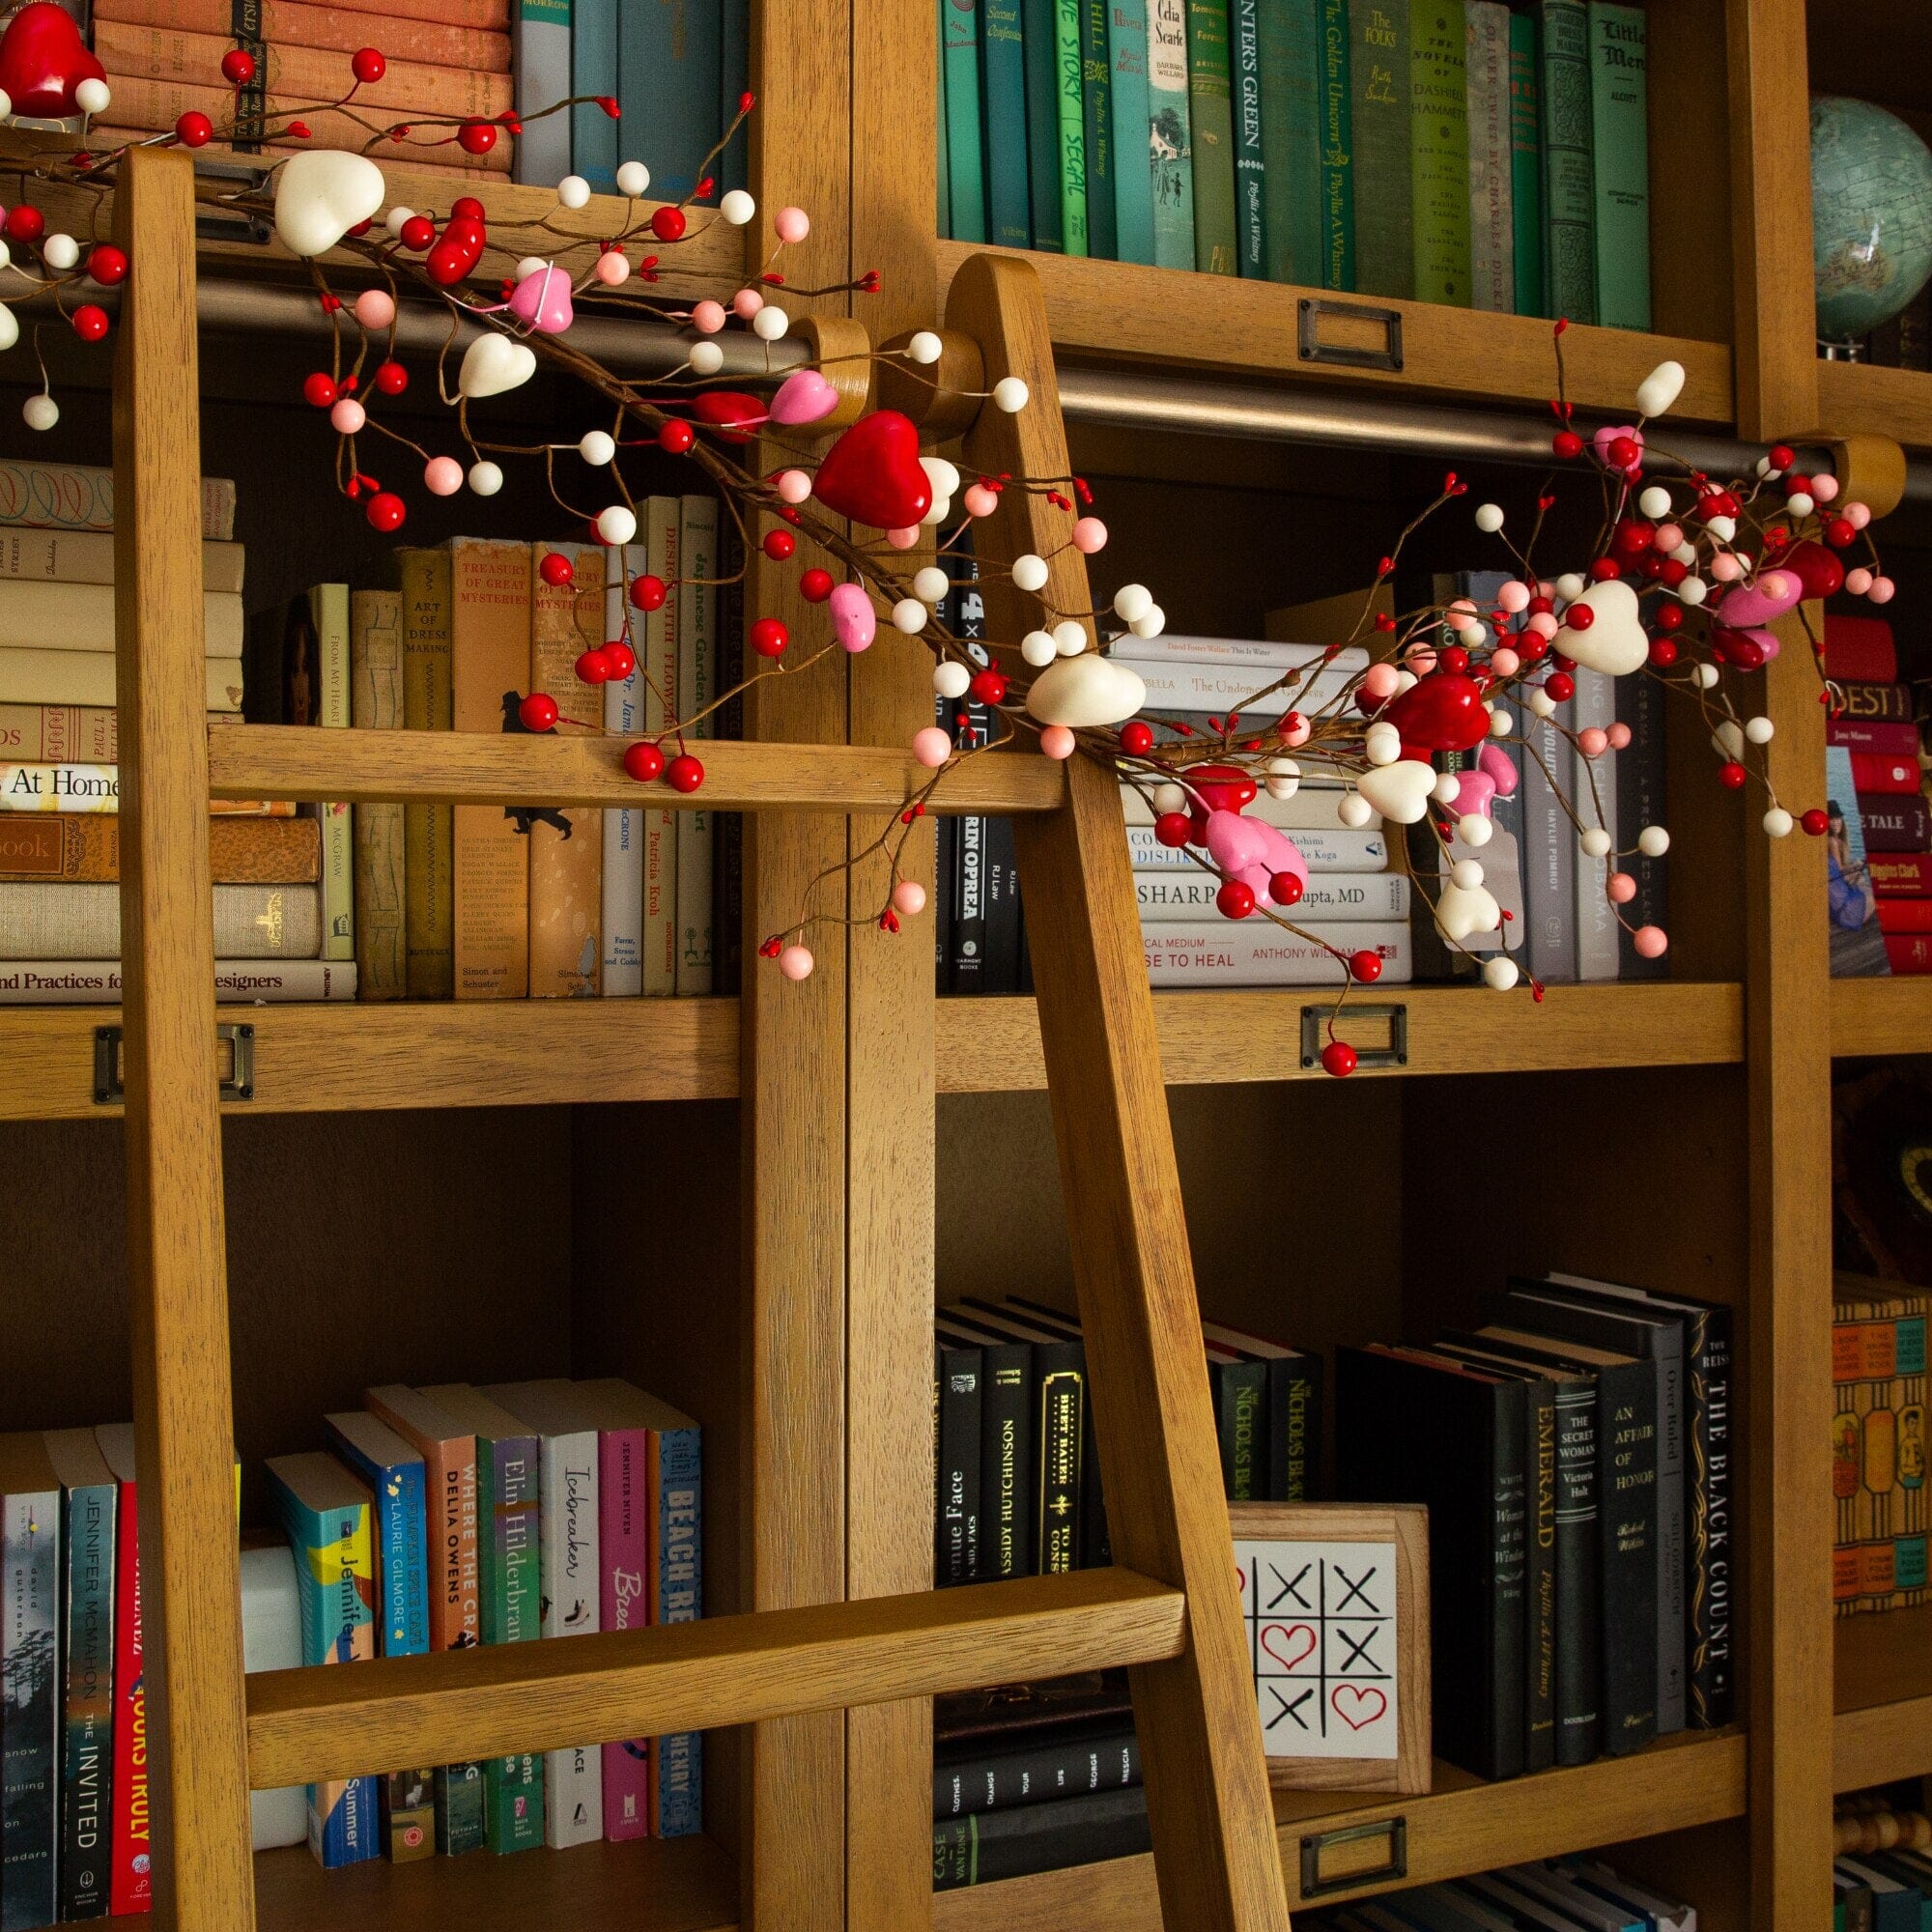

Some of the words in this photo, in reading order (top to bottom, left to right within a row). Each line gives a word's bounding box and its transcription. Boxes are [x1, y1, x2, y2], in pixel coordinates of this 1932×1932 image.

[1372, 11, 1390, 29] The
[1598, 19, 1646, 44] Little
[1063, 37, 1082, 104] STORY
[1324, 27, 1343, 80] Golden
[1486, 25, 1497, 85] OLIVER
[1598, 45, 1646, 69] Men
[1242, 77, 1260, 150] GREEN
[1326, 83, 1344, 145] Unicorn
[1488, 97, 1498, 141] TWIST
[1065, 133, 1086, 197] SEGAL
[1489, 150, 1499, 167] BY
[1330, 173, 1344, 214] Phyllis
[1490, 177, 1502, 250] CHARLES
[1328, 230, 1344, 290] Whitney
[12, 537, 20, 574] STREET
[463, 562, 526, 576] TREASURY
[665, 526, 676, 580] DESIG
[460, 593, 529, 606] MYSTERIES
[465, 579, 483, 588] OF
[486, 578, 526, 591] GREAT
[696, 553, 708, 634] Japanese
[413, 602, 440, 612] ART
[419, 616, 437, 625] OF
[665, 598, 675, 644] WITH
[406, 643, 449, 654] MAKING
[409, 629, 447, 639] DRESS
[1167, 641, 1186, 651] David
[1187, 642, 1207, 652] Foster
[1208, 643, 1231, 654] Wallace
[1230, 645, 1244, 655] This
[1252, 647, 1271, 657] Water
[330, 636, 340, 667] FROM
[330, 669, 340, 687] MY
[695, 639, 707, 703] Garden
[1191, 677, 1213, 693] The
[330, 688, 341, 724] HEART
[11, 768, 43, 795] At
[51, 770, 118, 797] Home
[1547, 810, 1557, 844] HAYLIE
[1868, 815, 1905, 830] TALE
[0, 834, 51, 858] ook
[108, 830, 117, 867] BONANZA
[649, 831, 661, 880] Patricia
[1315, 850, 1338, 862] Koga
[962, 852, 980, 921] OPREA
[991, 865, 1001, 879] RJ
[1548, 848, 1559, 892] POMROY
[649, 886, 661, 917] Kroh
[991, 880, 1001, 901] Law
[1137, 885, 1216, 904] SHARP
[1338, 889, 1365, 903] MD
[1165, 938, 1206, 949] MEDIUM
[1168, 954, 1191, 968] TO
[1195, 953, 1235, 968] HEAL
[1251, 948, 1308, 960] ANTHONY
[23, 973, 103, 990] Practices
[323, 966, 332, 998] WHITNEY
[462, 967, 490, 976] Simon
[492, 967, 508, 976] and
[462, 980, 500, 989] Schuster
[1666, 1369, 1678, 1408] Over
[1059, 1393, 1069, 1432] BRET
[1570, 1416, 1589, 1428] THE
[1614, 1406, 1634, 1422] AN
[1708, 1379, 1728, 1442] THE
[1559, 1443, 1596, 1459] WOMAN
[1560, 1430, 1595, 1444] SECRET
[1614, 1424, 1656, 1446] AFFAIR
[1666, 1413, 1679, 1461] Ruled
[622, 1441, 631, 1502] JENNIFER
[1000, 1419, 1013, 1521] HUTCHINSON
[1058, 1437, 1068, 1485] BAIER
[1614, 1452, 1633, 1467] OF
[504, 1459, 526, 1507] Elin
[1538, 1406, 1554, 1548] EMERALD
[1562, 1471, 1595, 1484] Victoria
[1571, 1485, 1589, 1498] Holt
[1615, 1469, 1656, 1491] HONOR
[446, 1470, 459, 1528] DELIA
[462, 1463, 476, 1540] WHERE
[946, 1469, 963, 1520] Face
[1708, 1454, 1728, 1550] BLACK
[391, 1501, 404, 1554] LAURIE
[564, 1467, 590, 1579] Icebreaker
[622, 1504, 631, 1536] NIVEN
[668, 1490, 695, 1582] BEACH
[1061, 1524, 1070, 1547] TO
[85, 1496, 100, 1593] JENNIFER
[447, 1534, 460, 1605] OWENS
[463, 1550, 476, 1590] THE
[340, 1556, 361, 1644] Jennifer
[392, 1556, 405, 1627] GILMORE
[1540, 1570, 1551, 1617] Phyllis
[1708, 1560, 1729, 1661] COUNT
[1538, 1641, 1550, 1700] Whitney
[84, 1713, 94, 1740] THE
[4, 1748, 38, 1759] snow
[670, 1736, 690, 1794] HENRY
[1089, 1752, 1098, 1789] GEORGE
[1121, 1747, 1130, 1783] BRESCIA
[4, 1781, 45, 1794] falling
[986, 1771, 995, 1805] CHANGE
[1021, 1771, 1030, 1796] YOUR
[1057, 1768, 1065, 1787] LIFE
[77, 1746, 99, 1849] INVITED
[344, 1778, 360, 1848] Summer
[4, 1819, 20, 1829] on
[957, 1825, 966, 1853] DINE
[4, 1850, 48, 1863] cedars
[933, 1834, 947, 1880] CASE
[956, 1855, 965, 1880] VAN
